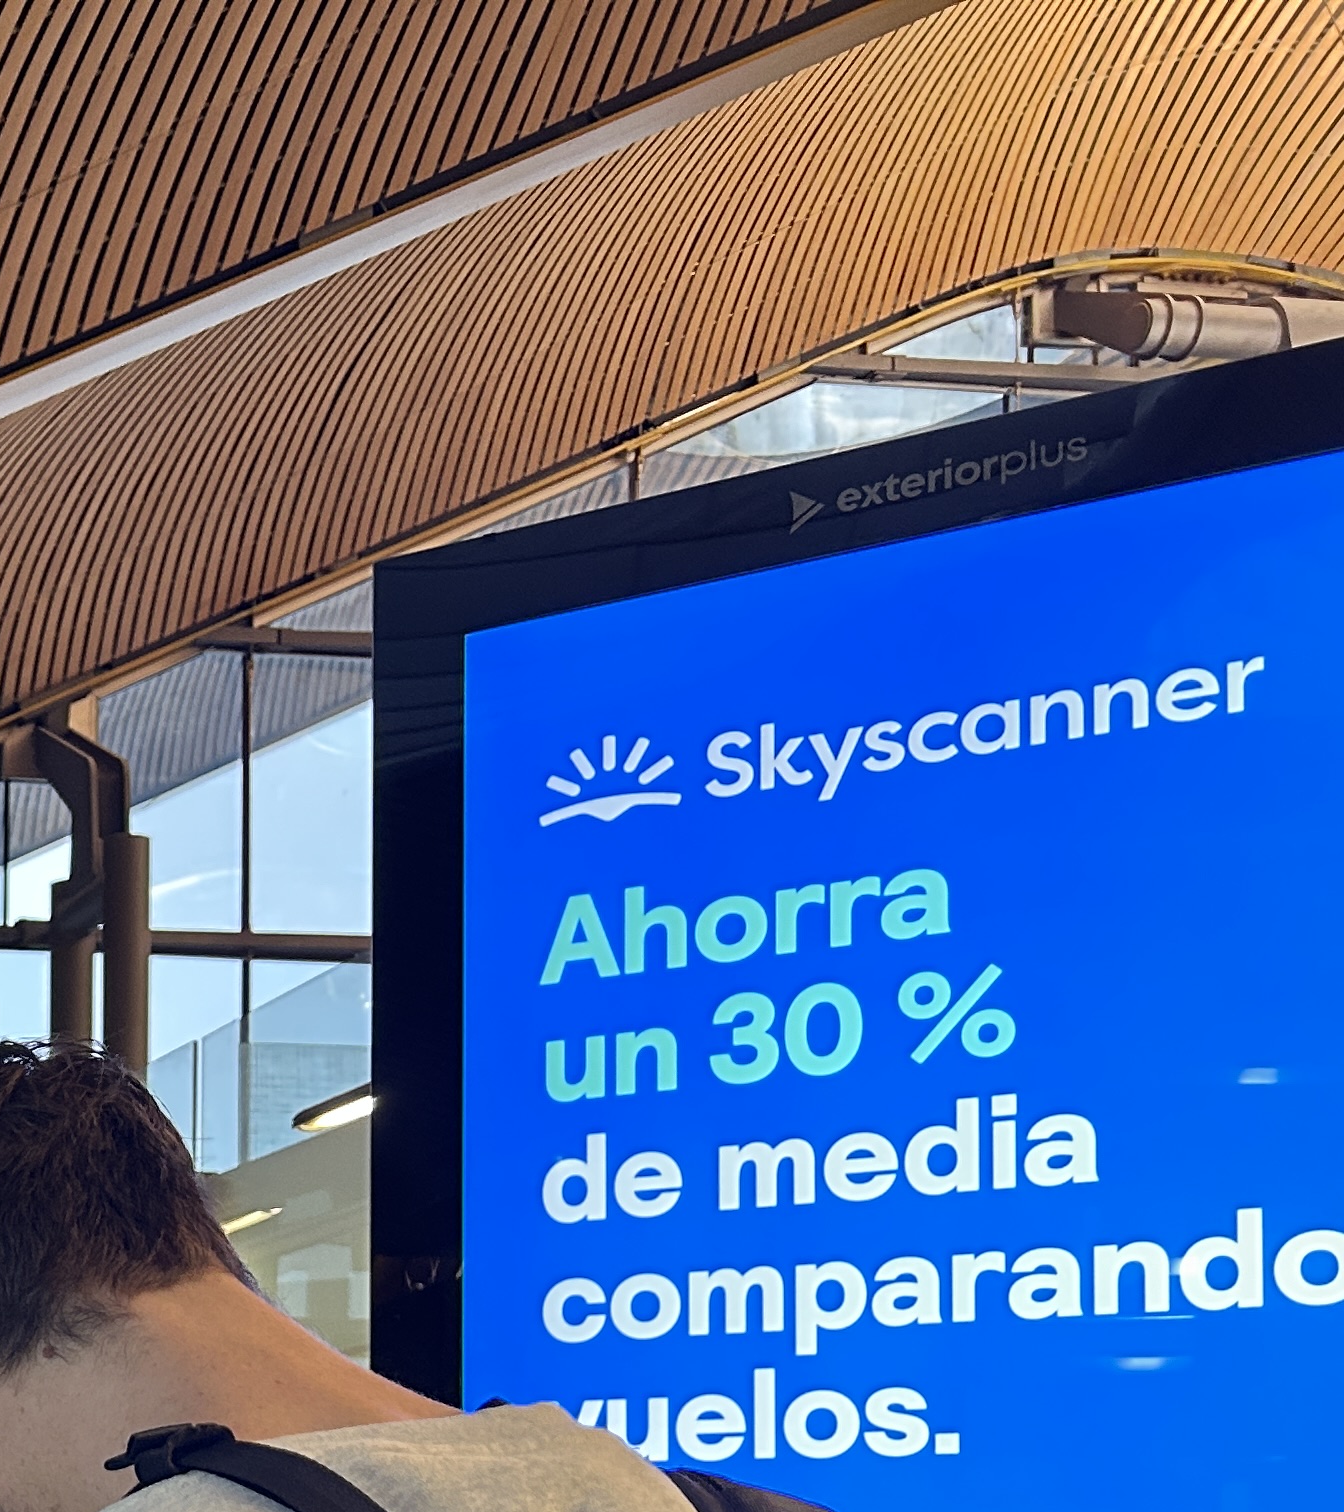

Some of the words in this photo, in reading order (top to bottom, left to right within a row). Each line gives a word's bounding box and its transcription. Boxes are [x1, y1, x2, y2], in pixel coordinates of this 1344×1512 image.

[836, 437, 1088, 512] exteriorplus
[705, 656, 1264, 801] Skyscanner
[539, 867, 951, 985] Ahorra
[544, 1027, 679, 1102] un
[711, 982, 864, 1086] 30
[898, 963, 1018, 1066] %
[542, 1132, 683, 1224] de
[718, 1093, 1100, 1211] media
[542, 1207, 1344, 1357] comparando
